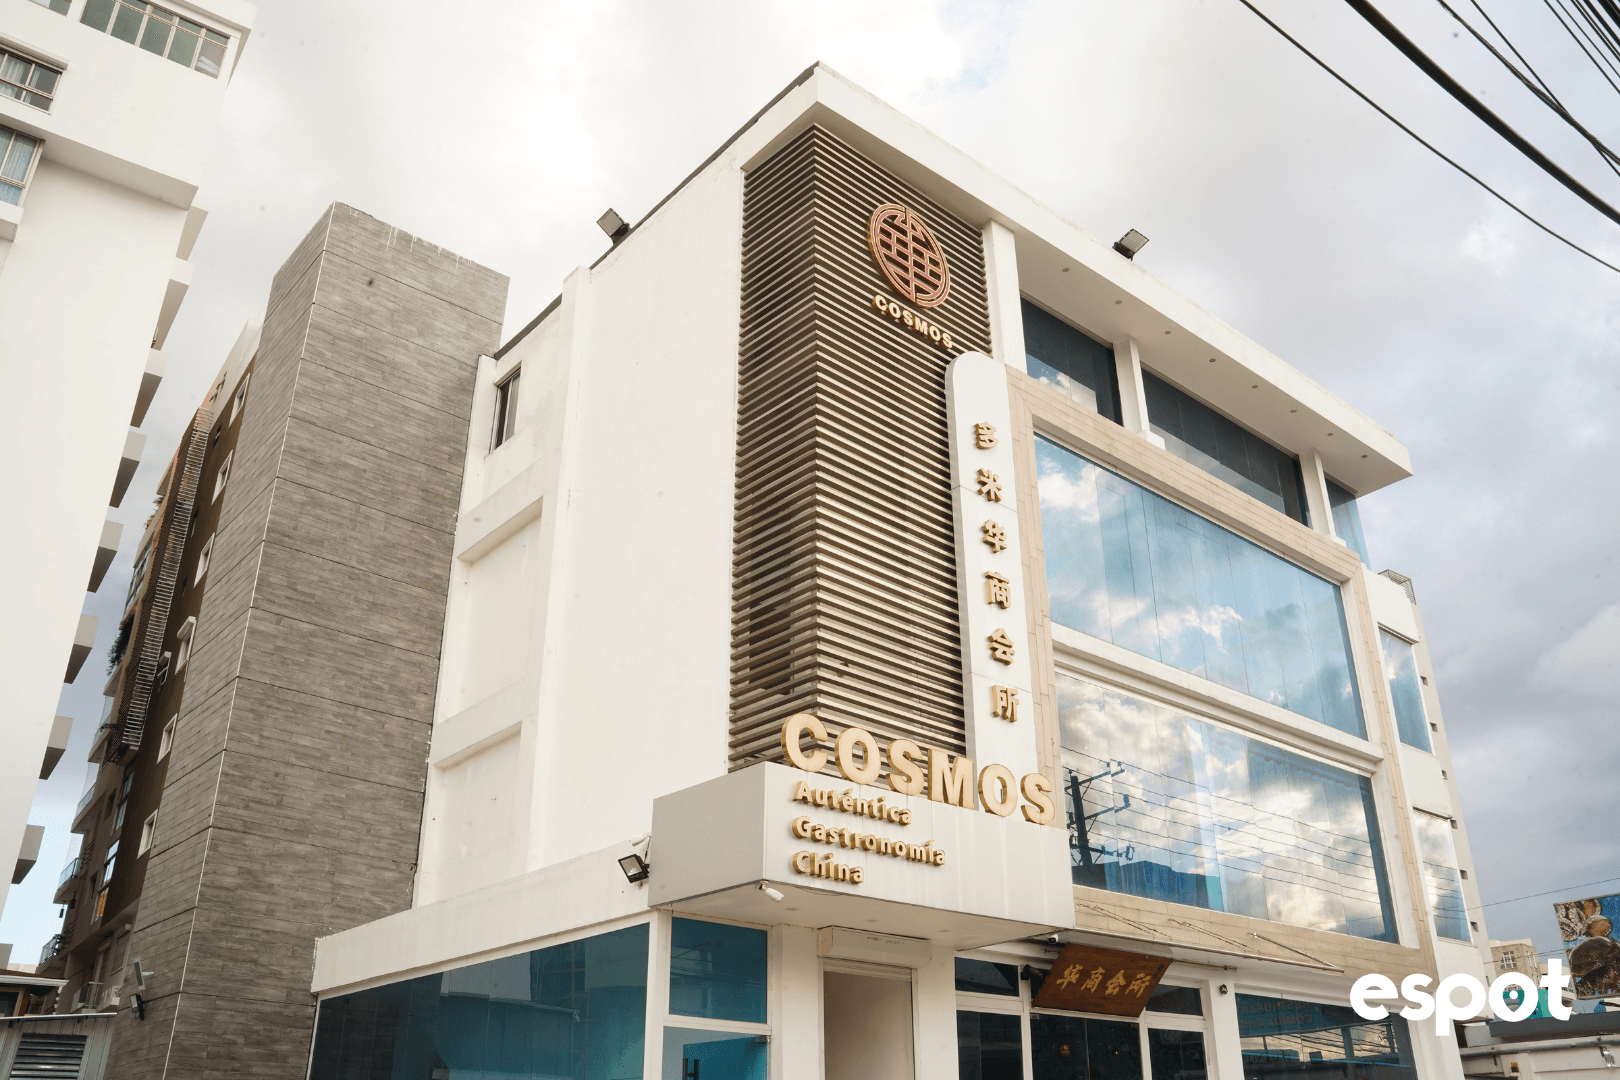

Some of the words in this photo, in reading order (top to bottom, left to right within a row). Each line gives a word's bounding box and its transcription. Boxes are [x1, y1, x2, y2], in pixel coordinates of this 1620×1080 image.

[872, 295, 953, 349] COSMOS
[975, 421, 1019, 722] 多米华商会所
[781, 713, 1055, 825] COSMOS
[793, 780, 912, 825] Auténtica
[792, 816, 946, 866] Gastronomía
[792, 851, 864, 884] China
